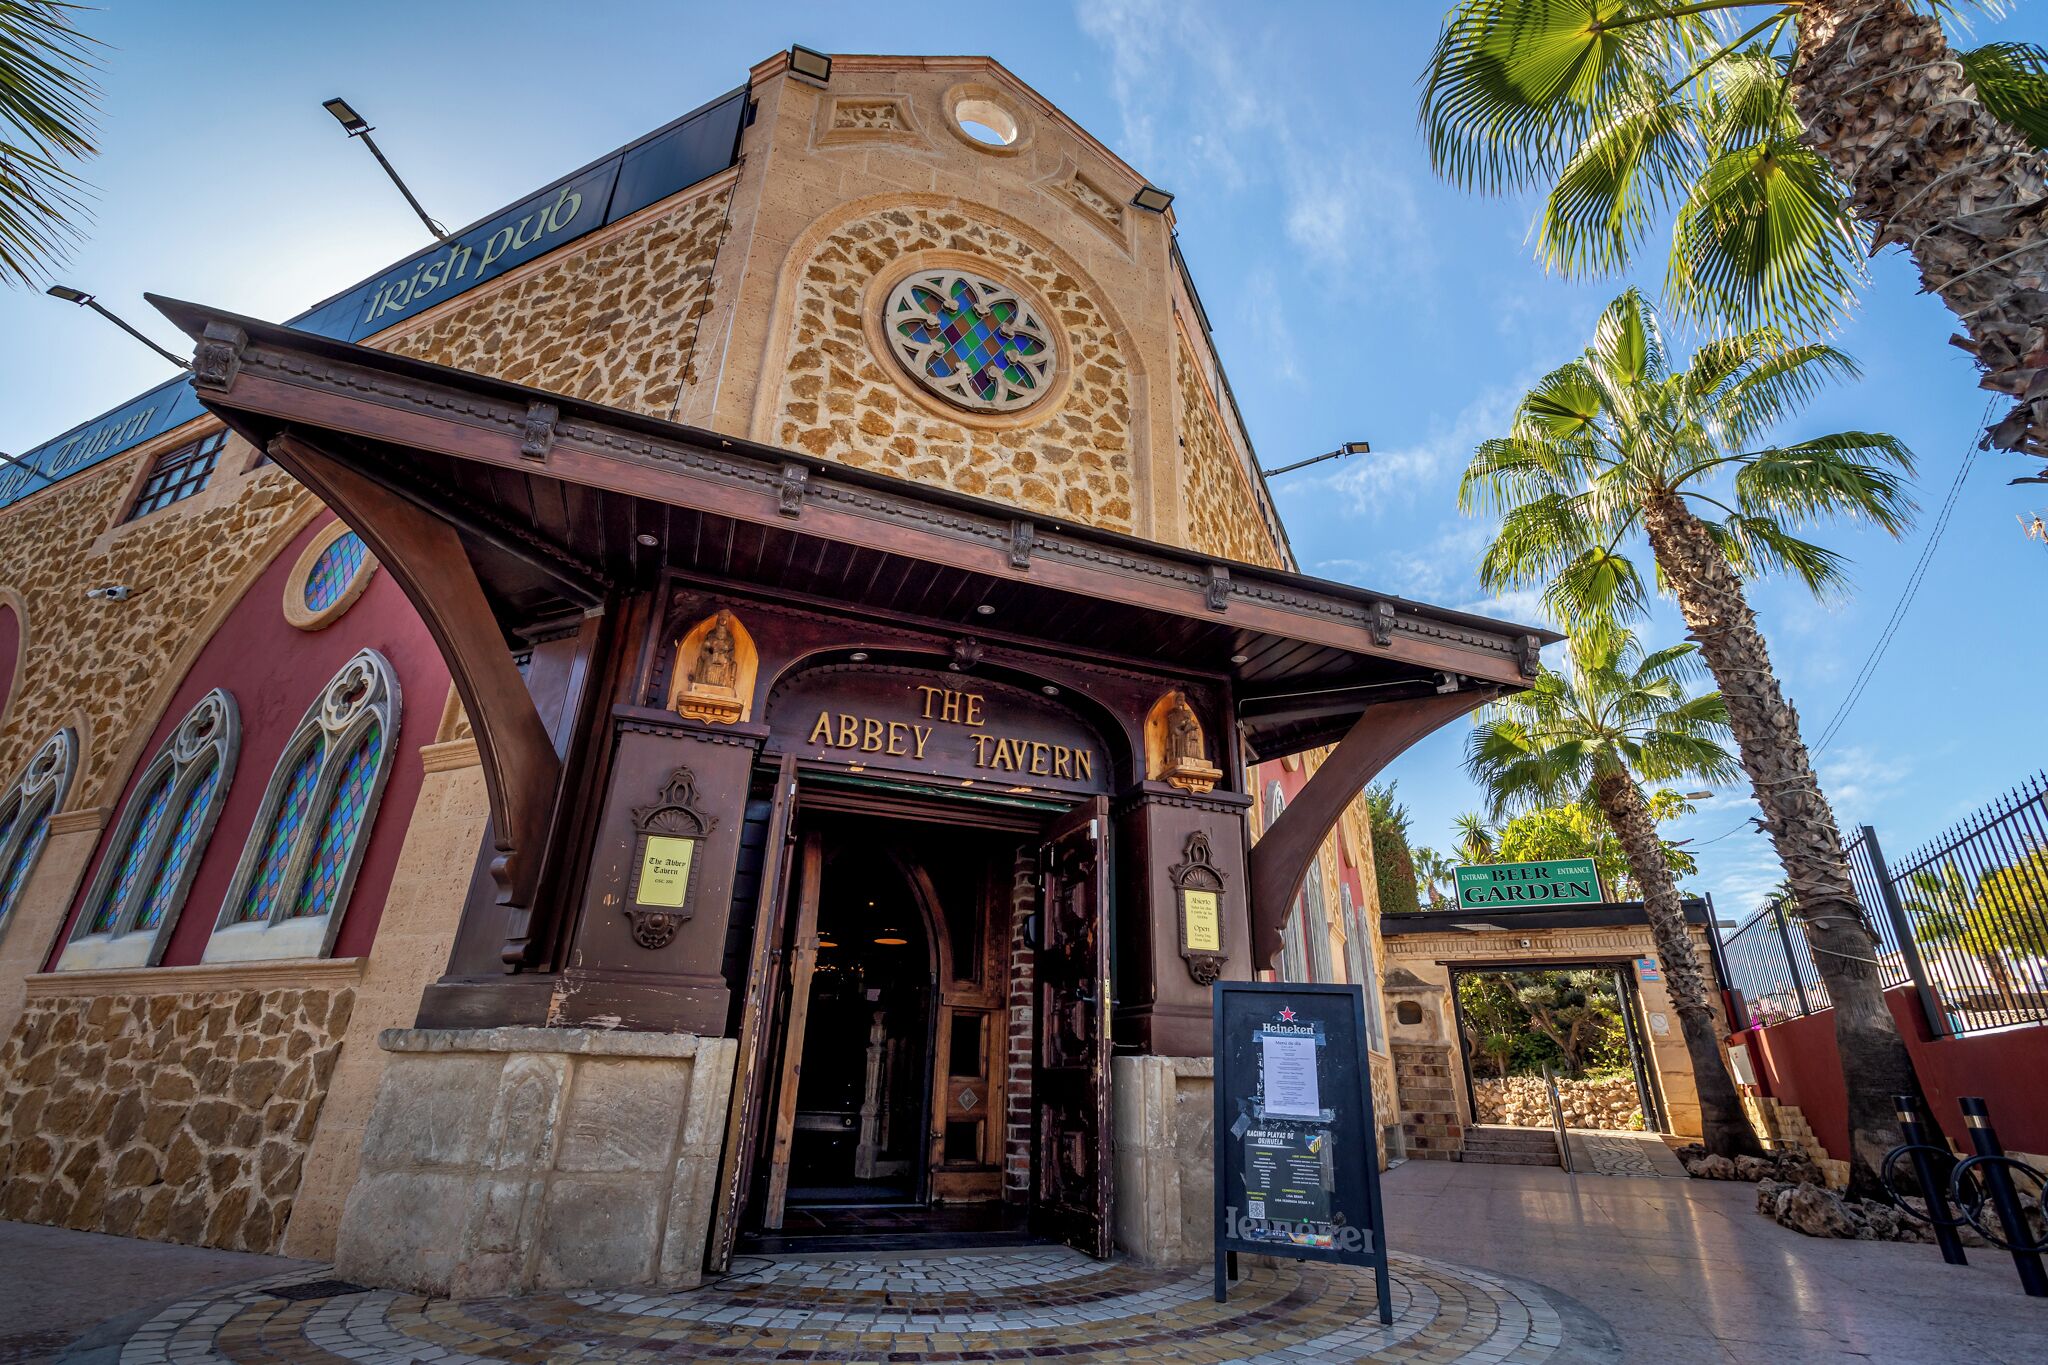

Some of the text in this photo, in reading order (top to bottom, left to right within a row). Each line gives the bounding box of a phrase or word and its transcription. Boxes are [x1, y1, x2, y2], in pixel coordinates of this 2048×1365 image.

[474, 186, 582, 279] pub
[46, 406, 158, 478] Tavern
[917, 685, 986, 727] THE
[808, 711, 1093, 781] ABBEY TAVERN
[648, 857, 686, 867] The Abbey
[653, 866, 678, 875] Tavern
[1490, 866, 1551, 883] BEER
[1557, 866, 1591, 875] ENTRANCE
[1461, 873, 1489, 881] ENTRADA
[1463, 881, 1591, 904] GARDEN
[1191, 897, 1211, 905] Abierto
[1193, 924, 1210, 933] Open
[1262, 1022, 1314, 1035] Heineken
[1247, 1129, 1266, 1138] RACING
[1267, 1131, 1286, 1139] PLAYAS
[1257, 1138, 1283, 1146] ORIHUELA
